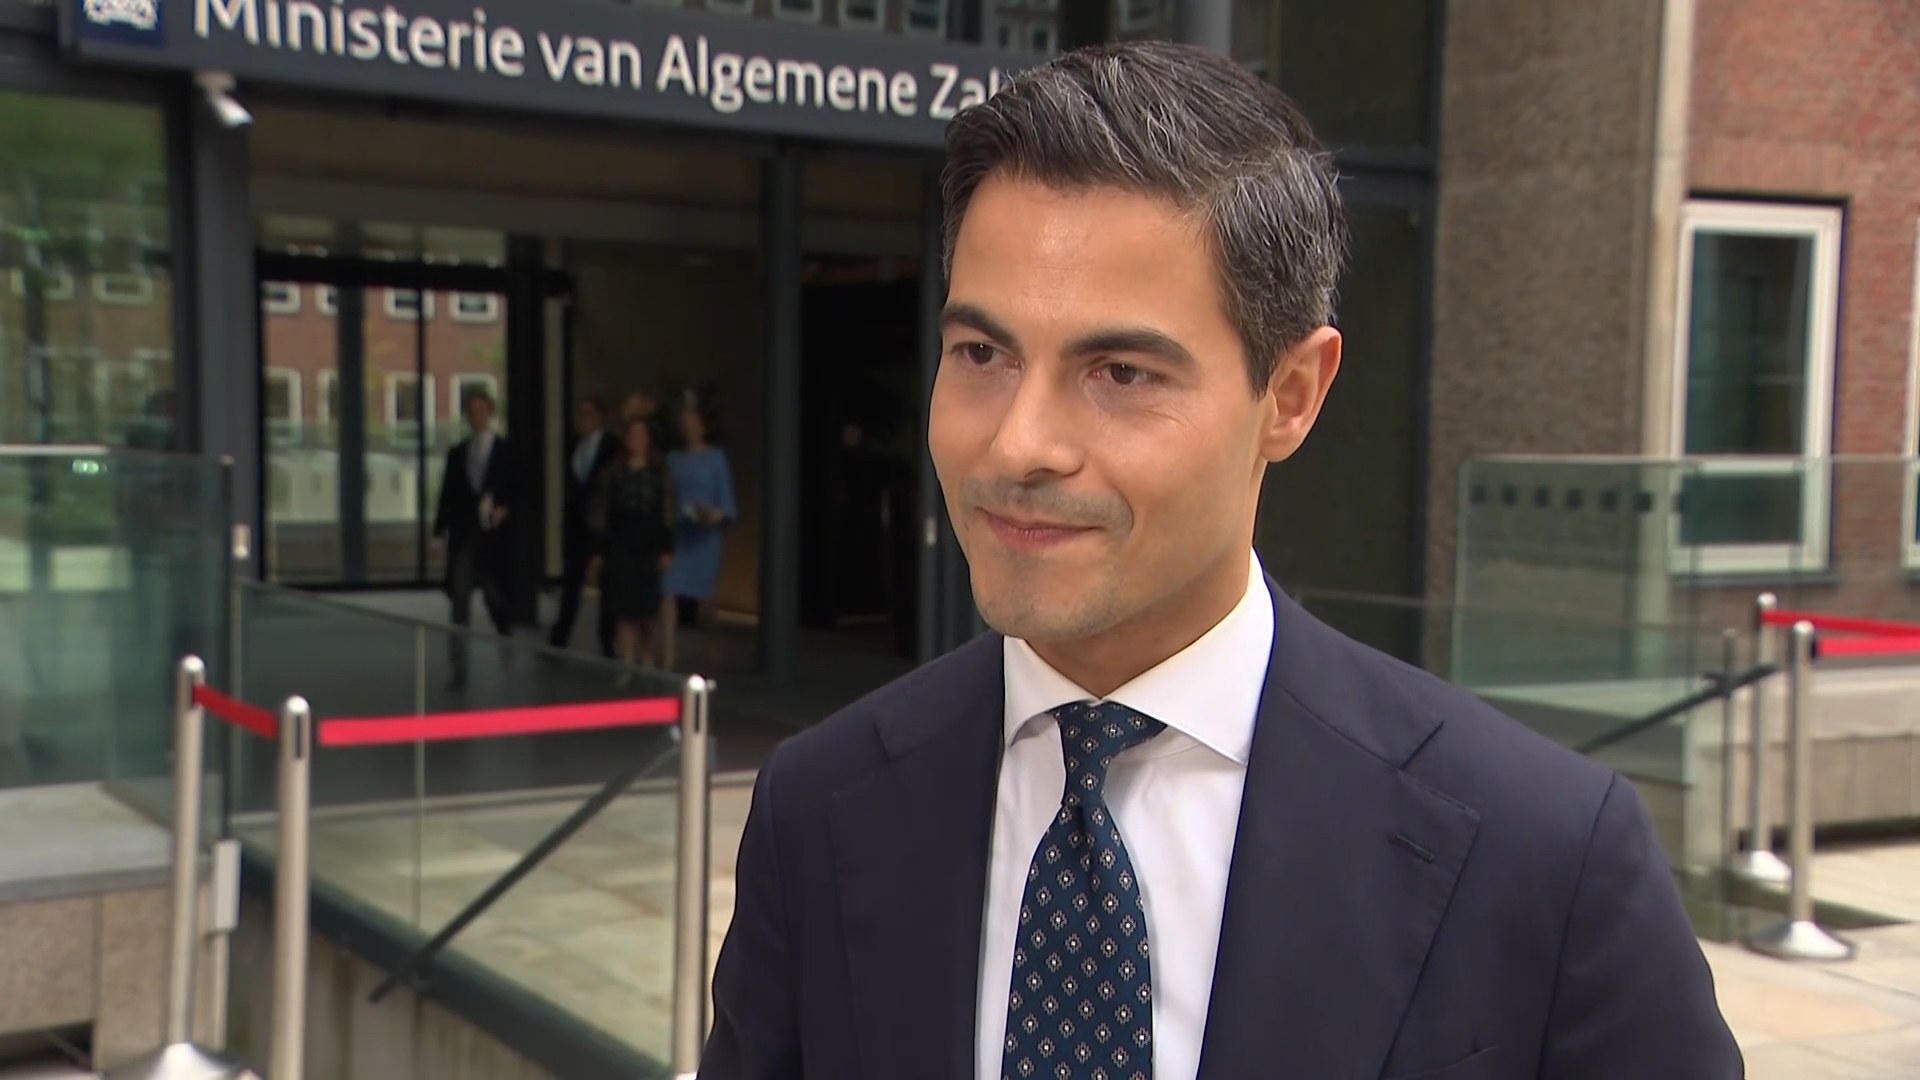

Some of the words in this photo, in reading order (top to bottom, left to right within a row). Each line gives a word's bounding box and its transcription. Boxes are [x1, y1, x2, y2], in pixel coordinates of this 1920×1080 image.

[194, 0, 526, 77] Ministerie
[537, 31, 642, 90] van
[655, 33, 918, 117] Algemene
